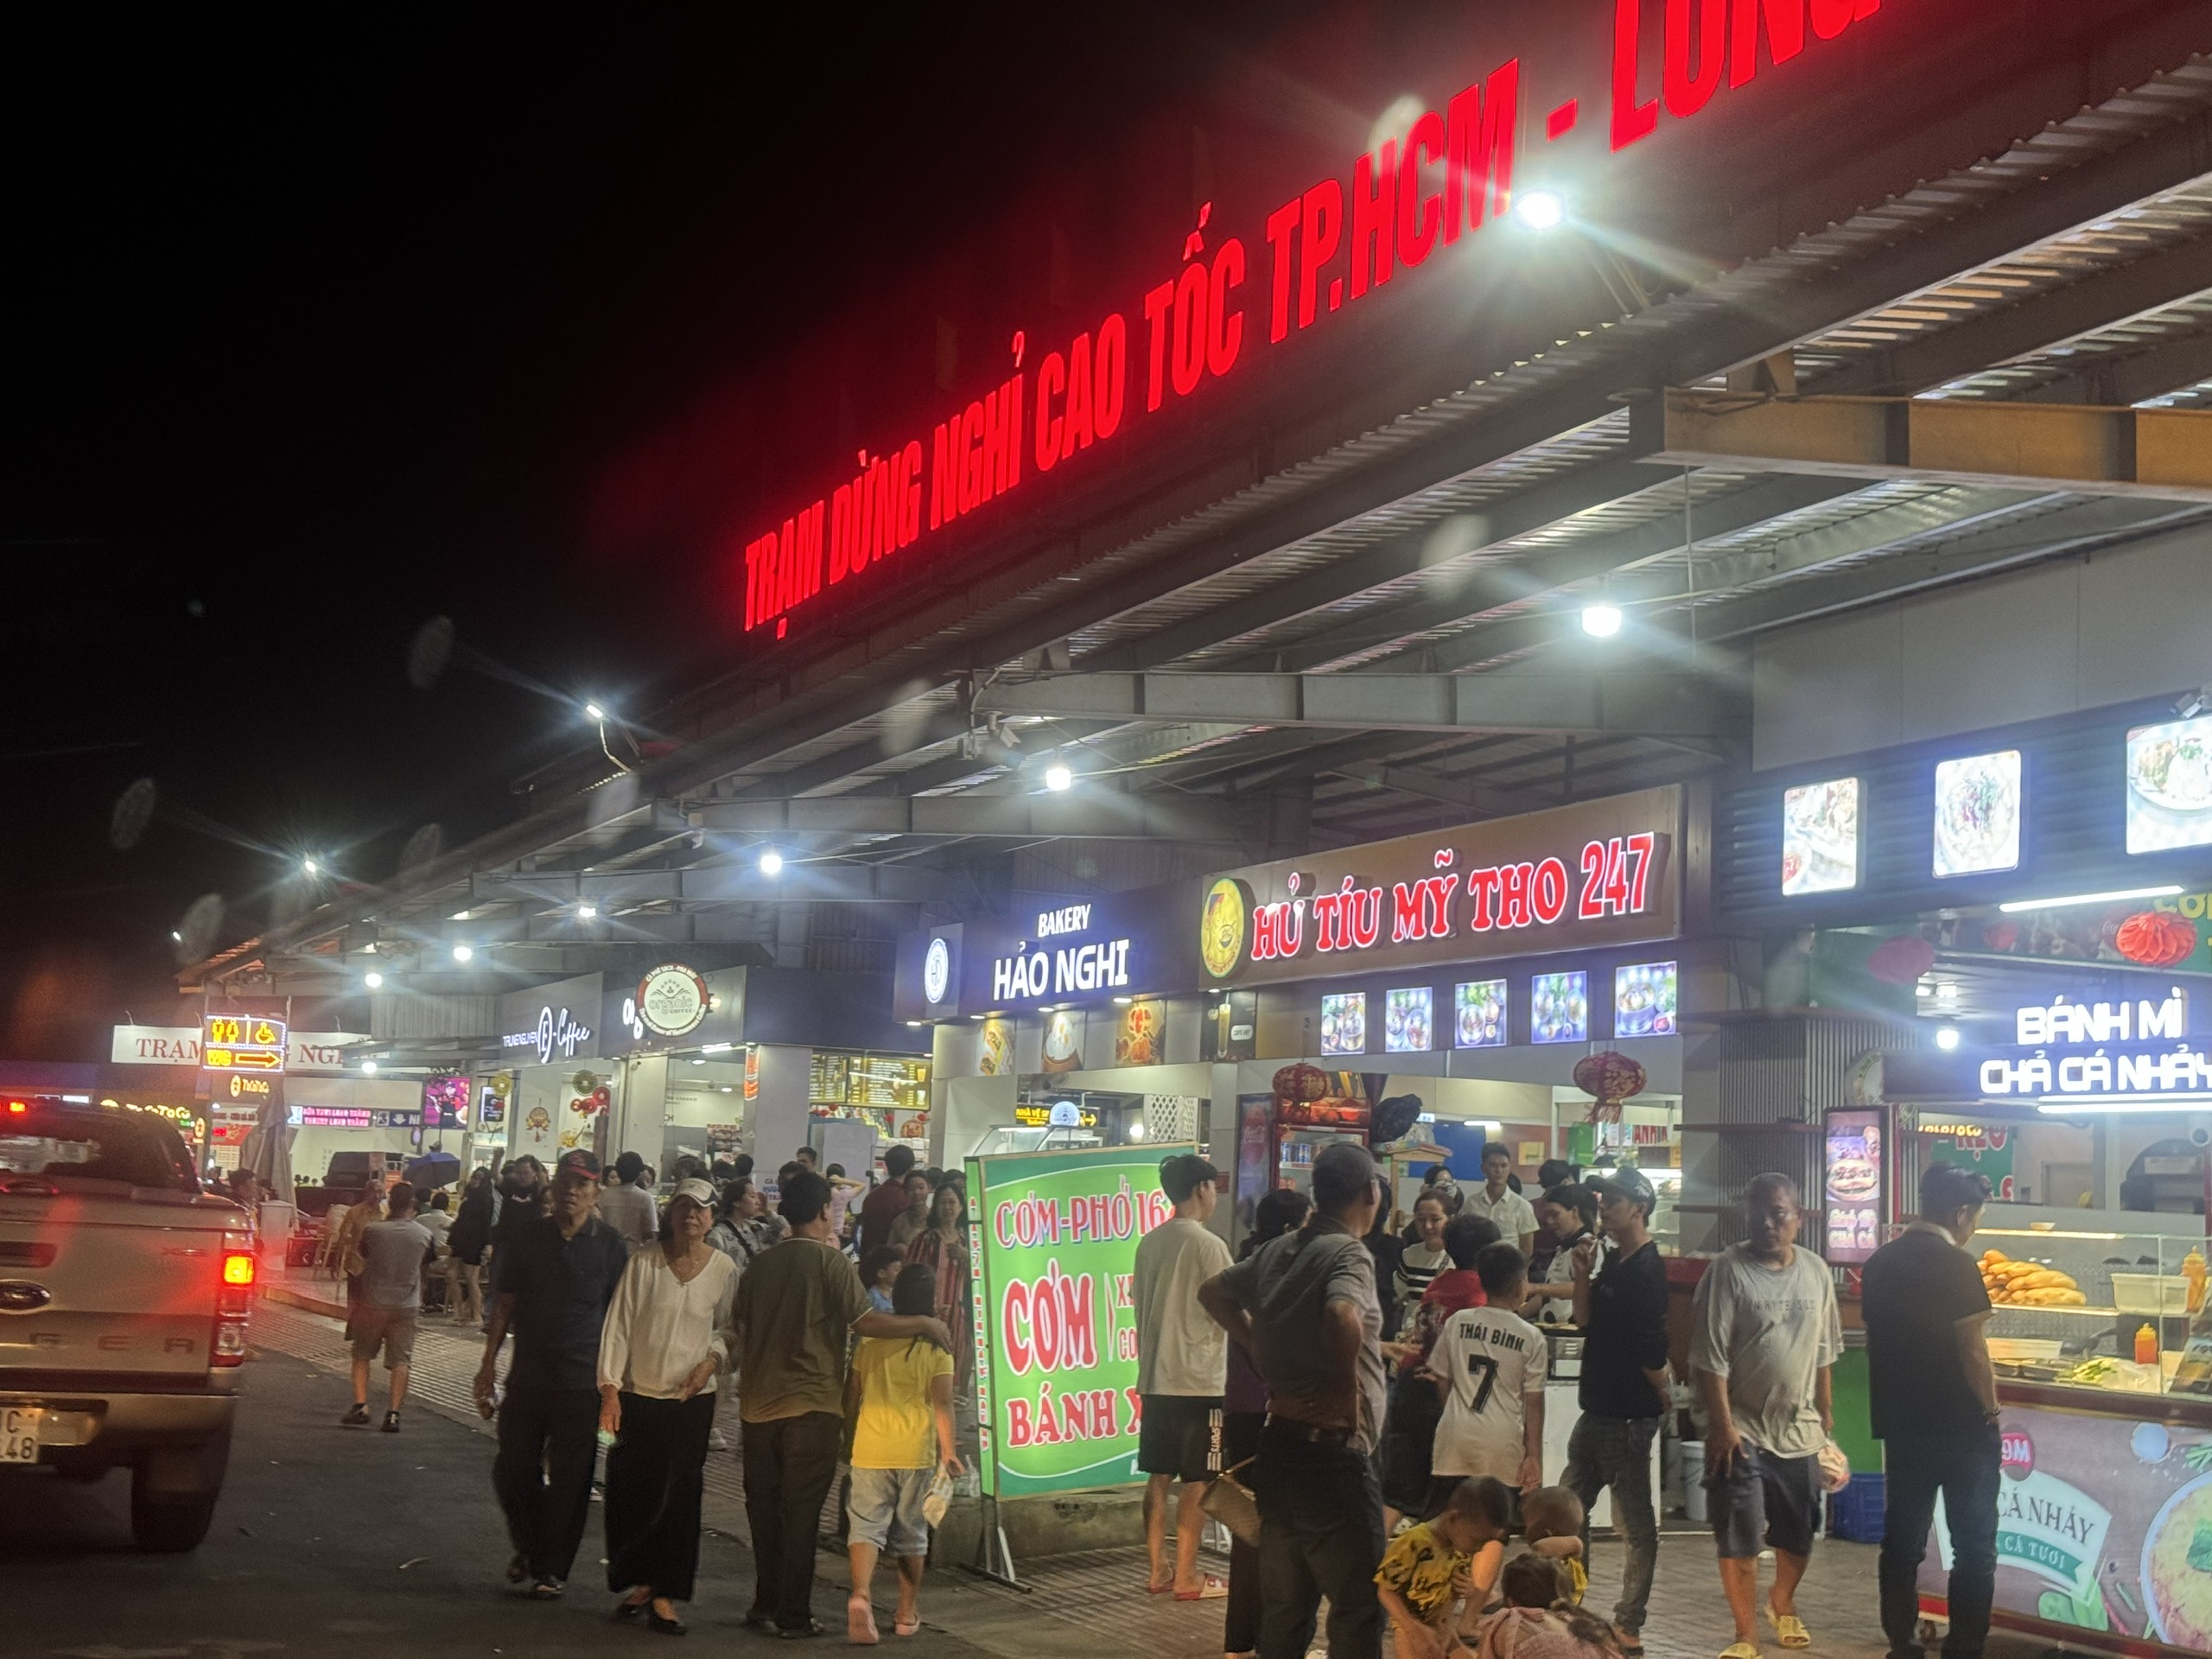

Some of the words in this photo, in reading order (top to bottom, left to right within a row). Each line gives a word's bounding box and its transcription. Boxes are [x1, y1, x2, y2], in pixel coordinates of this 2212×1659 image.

[744, 500, 823, 639] TRẠM
[830, 450, 922, 585] DỪNG
[931, 331, 1024, 531] NGHỈ
[1037, 314, 1125, 471] CAO
[1146, 201, 1246, 413] TỐC
[1266, 57, 1517, 344] TP.HCM
[1610, 0, 1880, 153] LO
[1038, 904, 1091, 938] BAKERY
[1250, 871, 1306, 961] HỦ
[1313, 874, 1382, 952] TÍU
[1392, 849, 1459, 943] MỸ
[1468, 856, 1568, 933] THO
[1578, 830, 1655, 921] 247
[994, 941, 1050, 1001] HẢO
[1054, 938, 1130, 995] NGHI
[2016, 995, 2131, 1046] BÁNH
[2139, 986, 2184, 1040] MÌ
[207, 1049, 232, 1066] WC
[1980, 1049, 2052, 1094] CHẢ
[2058, 1048, 2111, 1092] CÁ
[995, 1174, 1135, 1249] CƠM-PHỞ
[1135, 1188, 1175, 1236] 16
[1001, 1257, 1099, 1376] CƠM
[1459, 1322, 1488, 1341] THÁI
[1491, 1327, 1525, 1352] BÌNH
[1468, 1353, 1499, 1414] 7
[1006, 1381, 1121, 1450] BÁNH
[2005, 1535, 2024, 1553] CÁ
